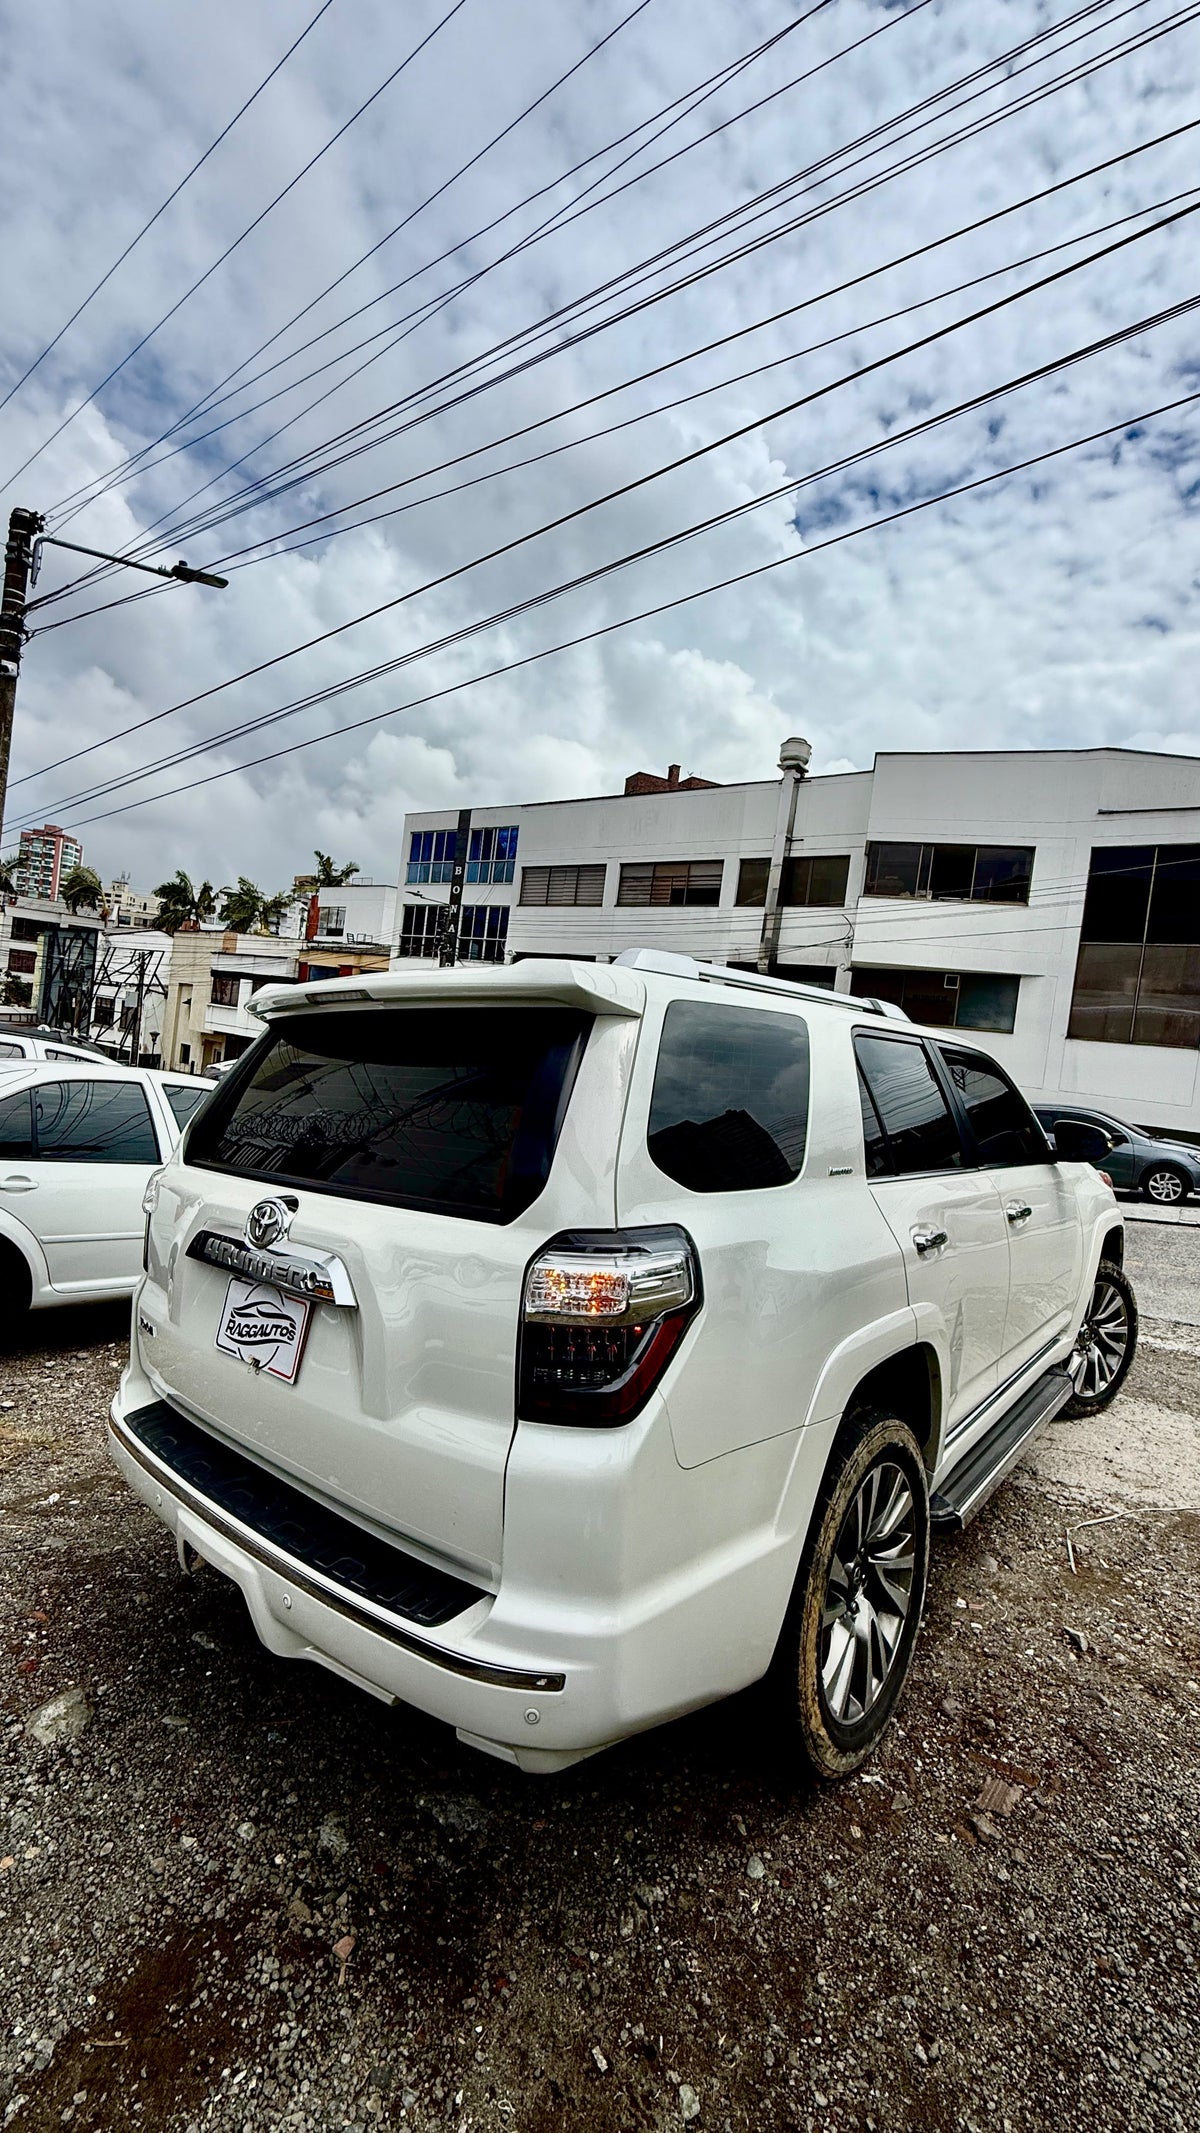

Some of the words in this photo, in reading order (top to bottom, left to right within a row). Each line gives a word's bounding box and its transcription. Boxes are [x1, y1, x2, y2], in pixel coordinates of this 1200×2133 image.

[445, 866, 462, 967] BONA
[204, 1238, 307, 1290] 4RUNNER
[225, 1318, 297, 1341] RAGGAUTOS
